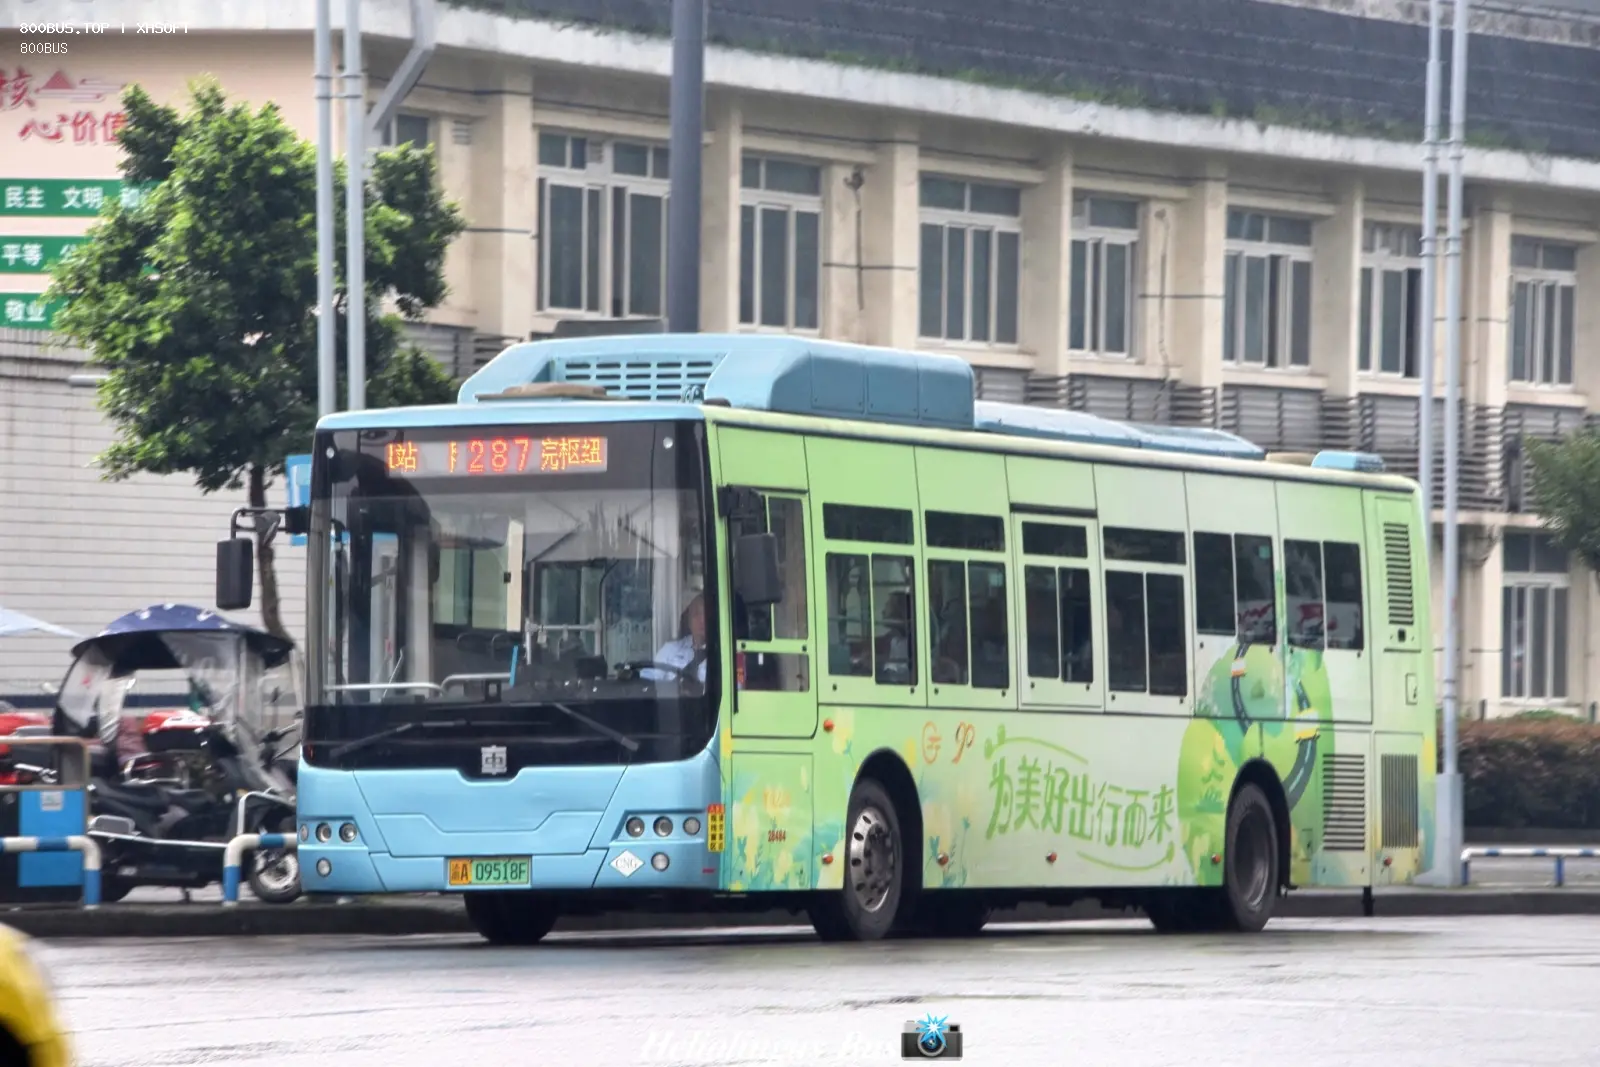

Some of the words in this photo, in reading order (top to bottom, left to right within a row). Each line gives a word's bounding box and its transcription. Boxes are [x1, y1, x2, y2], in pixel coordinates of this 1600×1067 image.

[5, 186, 46, 208] 民主
[62, 186, 103, 209] 文明
[2, 243, 43, 266] 平等
[4, 300, 46, 322] 敬业
[470, 438, 528, 473] 287
[986, 755, 1175, 848] 为美好出行而来
[615, 857, 637, 869] CNG
